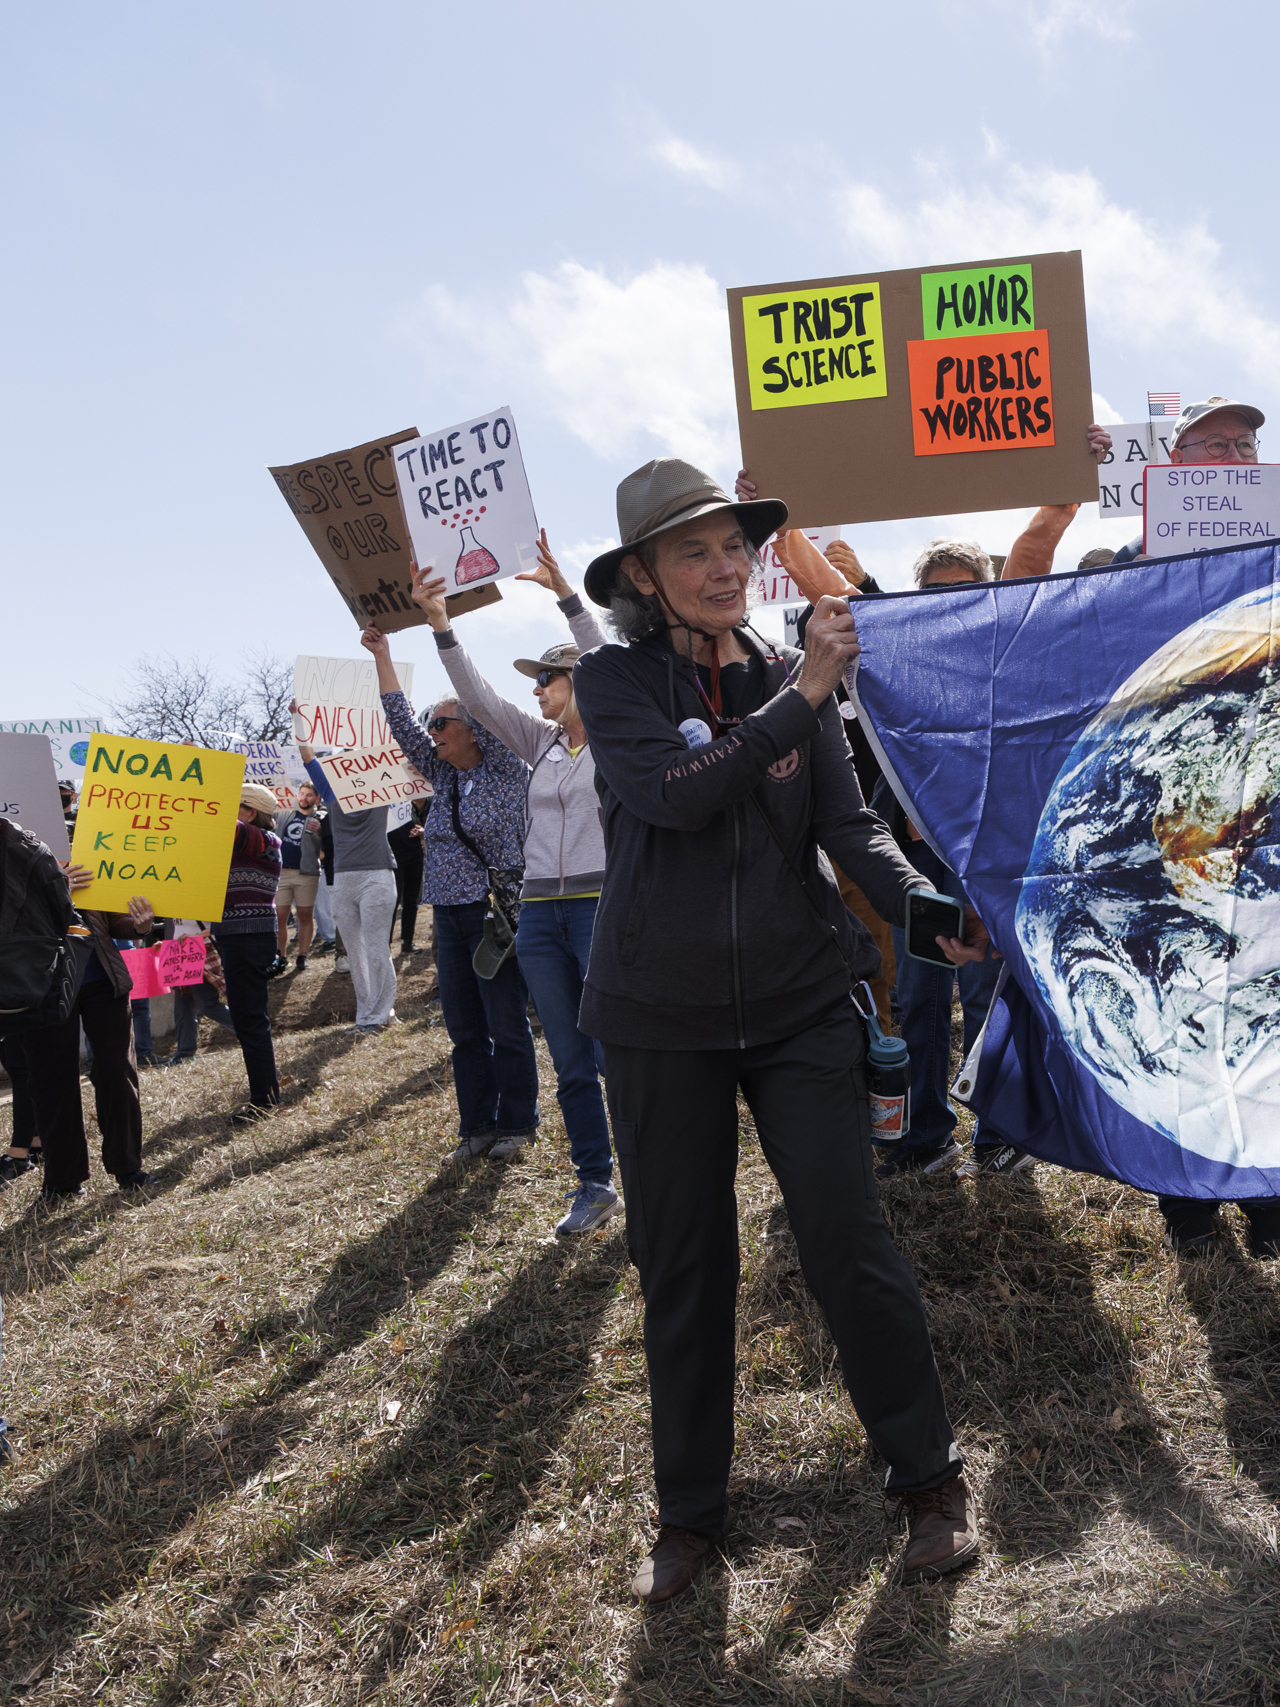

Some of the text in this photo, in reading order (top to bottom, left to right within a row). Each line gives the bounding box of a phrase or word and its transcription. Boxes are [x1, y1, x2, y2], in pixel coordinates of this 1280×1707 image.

[758, 292, 874, 344] TRUST
[936, 274, 1031, 331] HONOR
[762, 340, 877, 393] SCIENCE
[935, 347, 1042, 400] PUBLIC
[919, 396, 1052, 444] WORKERS
[398, 417, 511, 483] TIME TO
[418, 459, 505, 519] REACT
[1167, 470, 1261, 486] STOP THE
[1182, 496, 1242, 511] STEAL
[327, 513, 401, 561] OUR
[1157, 522, 1275, 537] OF FEDERAL
[295, 703, 392, 748] SAVES LIV
[689, 734, 701, 744] WITH
[92, 747, 204, 785] NOAA
[322, 749, 405, 779] TRUMP
[351, 771, 393, 789] IS A
[87, 784, 221, 816] PROTECTS
[339, 779, 433, 810] TRAITOR
[131, 814, 174, 831] US
[93, 831, 177, 852] KEEP
[97, 860, 182, 883] NOAA
